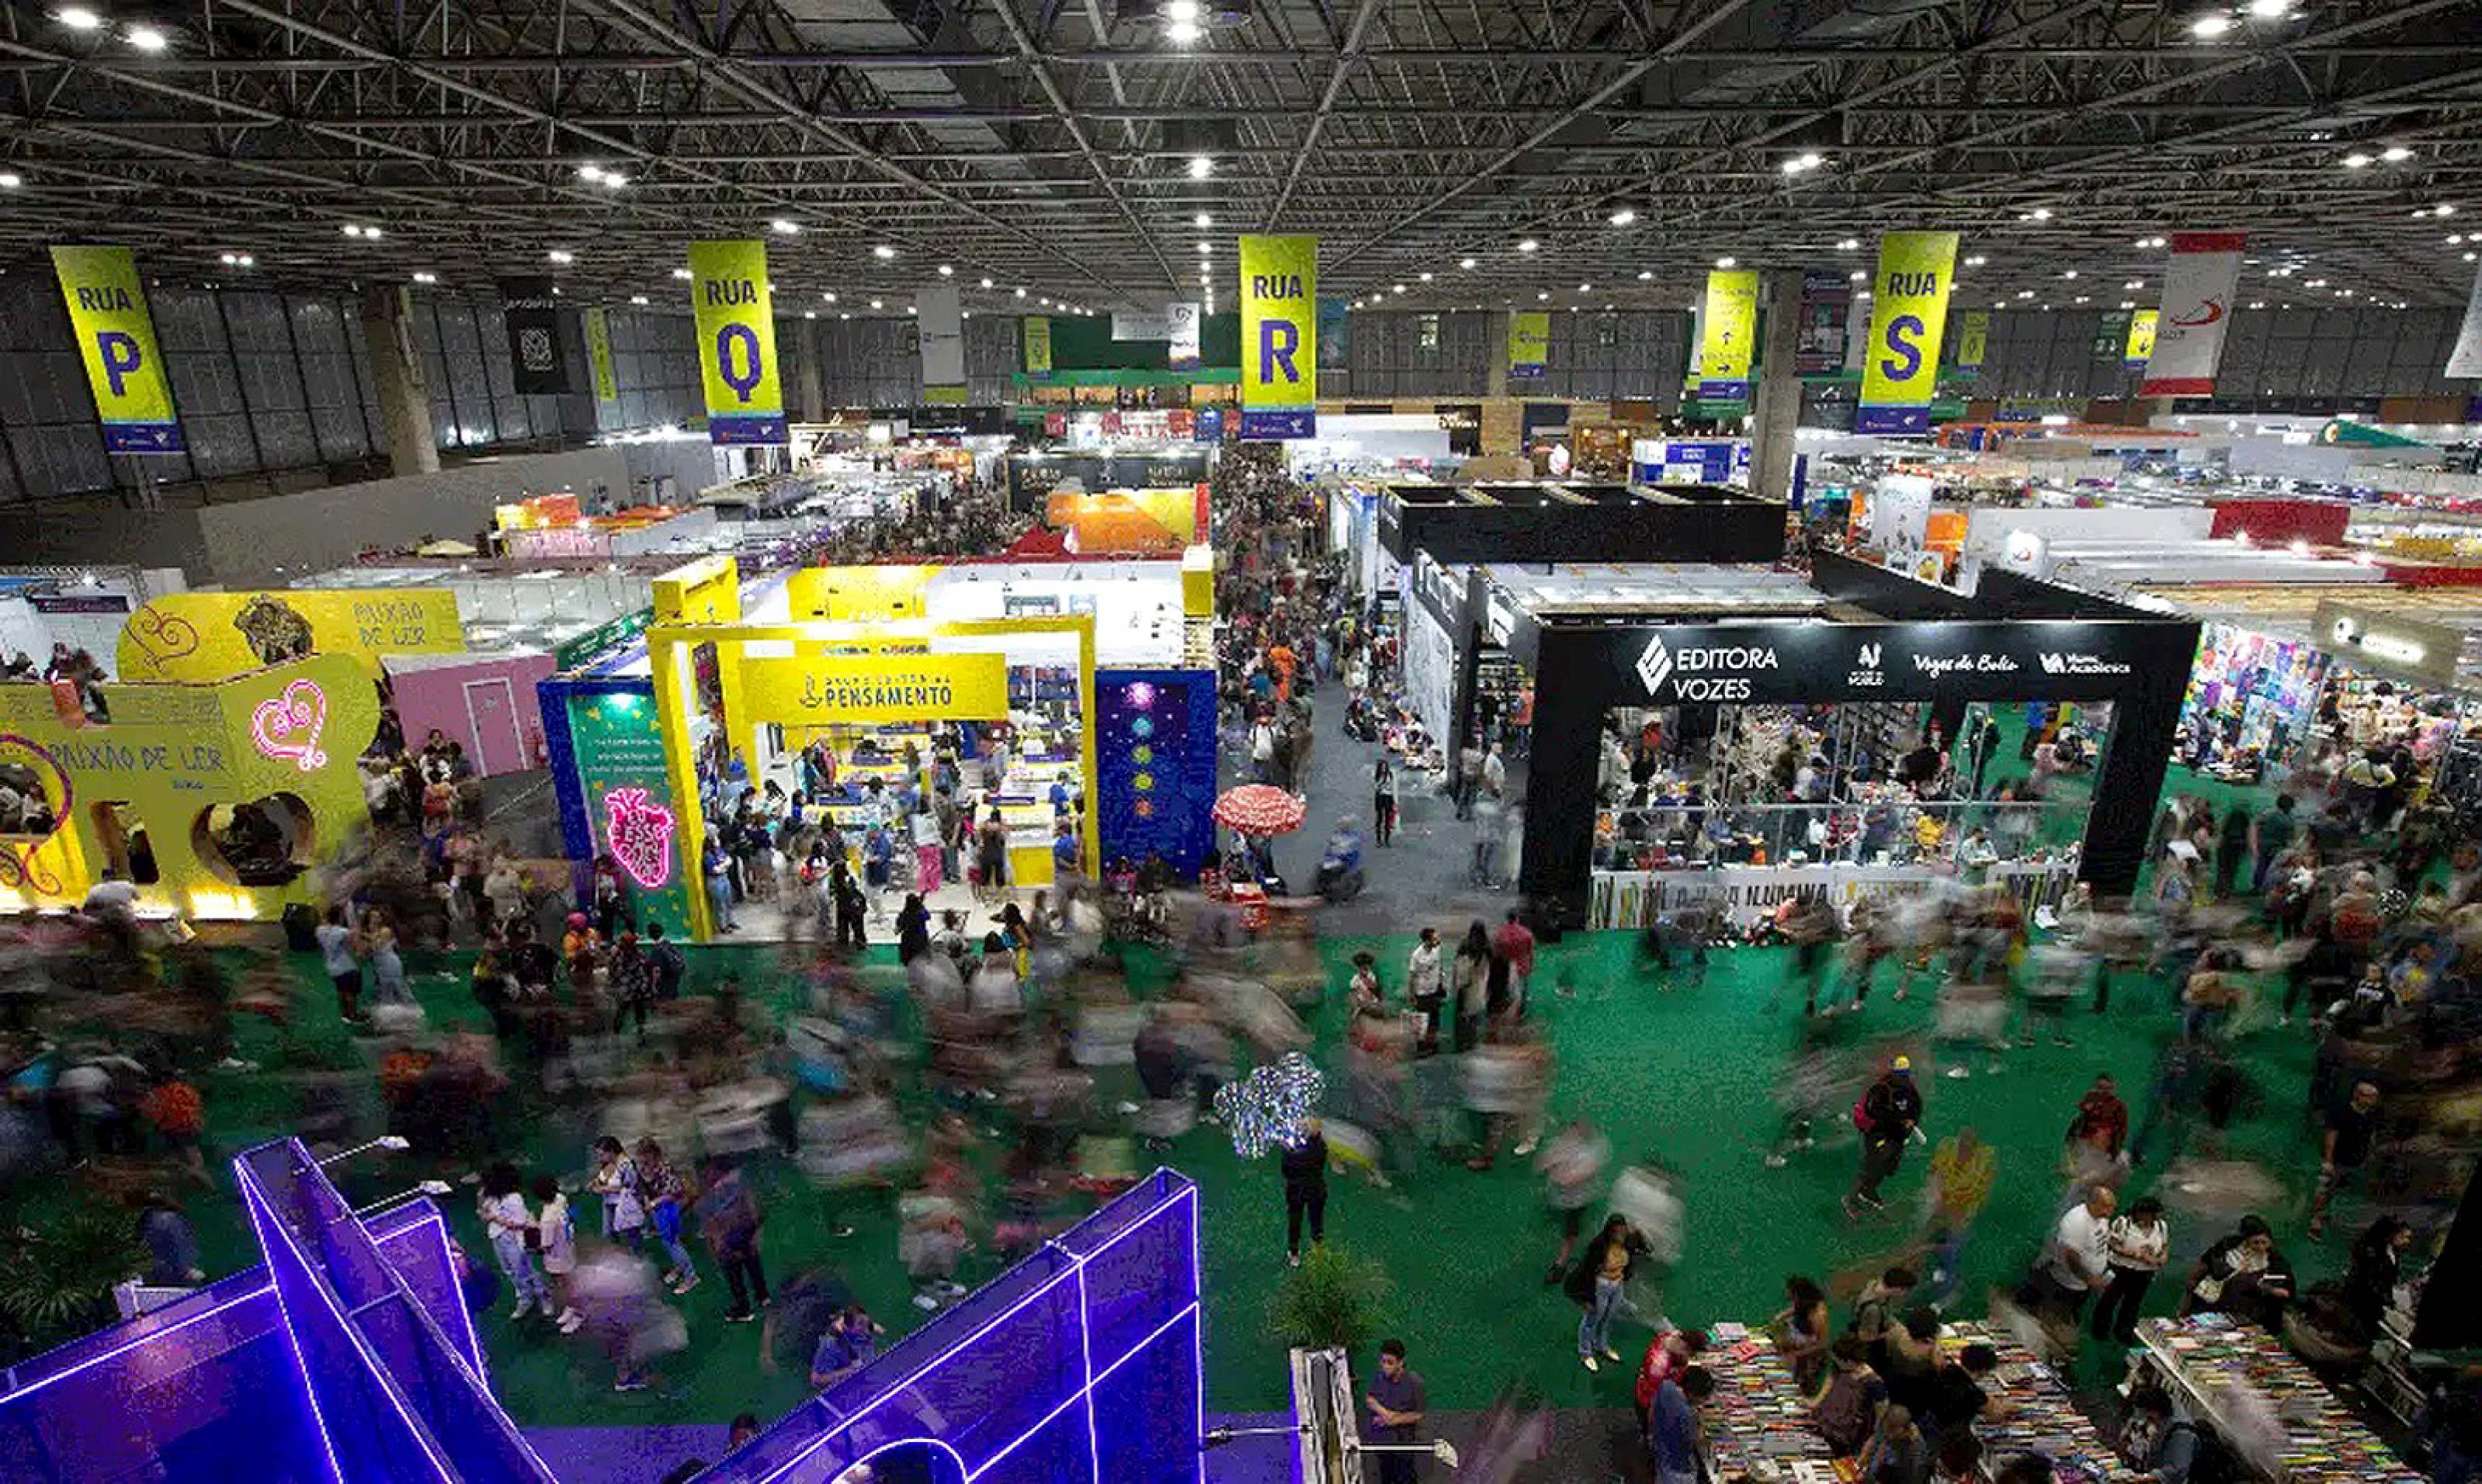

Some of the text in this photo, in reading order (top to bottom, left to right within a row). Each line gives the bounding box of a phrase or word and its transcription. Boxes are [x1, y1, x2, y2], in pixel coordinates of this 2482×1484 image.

[706, 279, 758, 306] RUA
[1252, 275, 1303, 300] RUA
[1888, 272, 1936, 297] RUA
[77, 286, 134, 311] RUA
[1259, 320, 1300, 384] R
[1880, 314, 1925, 382] S
[96, 331, 141, 397] P
[717, 322, 762, 402] Q
[1676, 647, 1779, 671] EDITORA
[824, 686, 953, 709] PENSAMENTO
[1672, 678, 1751, 701] VOZES
[141, 744, 172, 771] DE
[178, 744, 225, 771] LER
